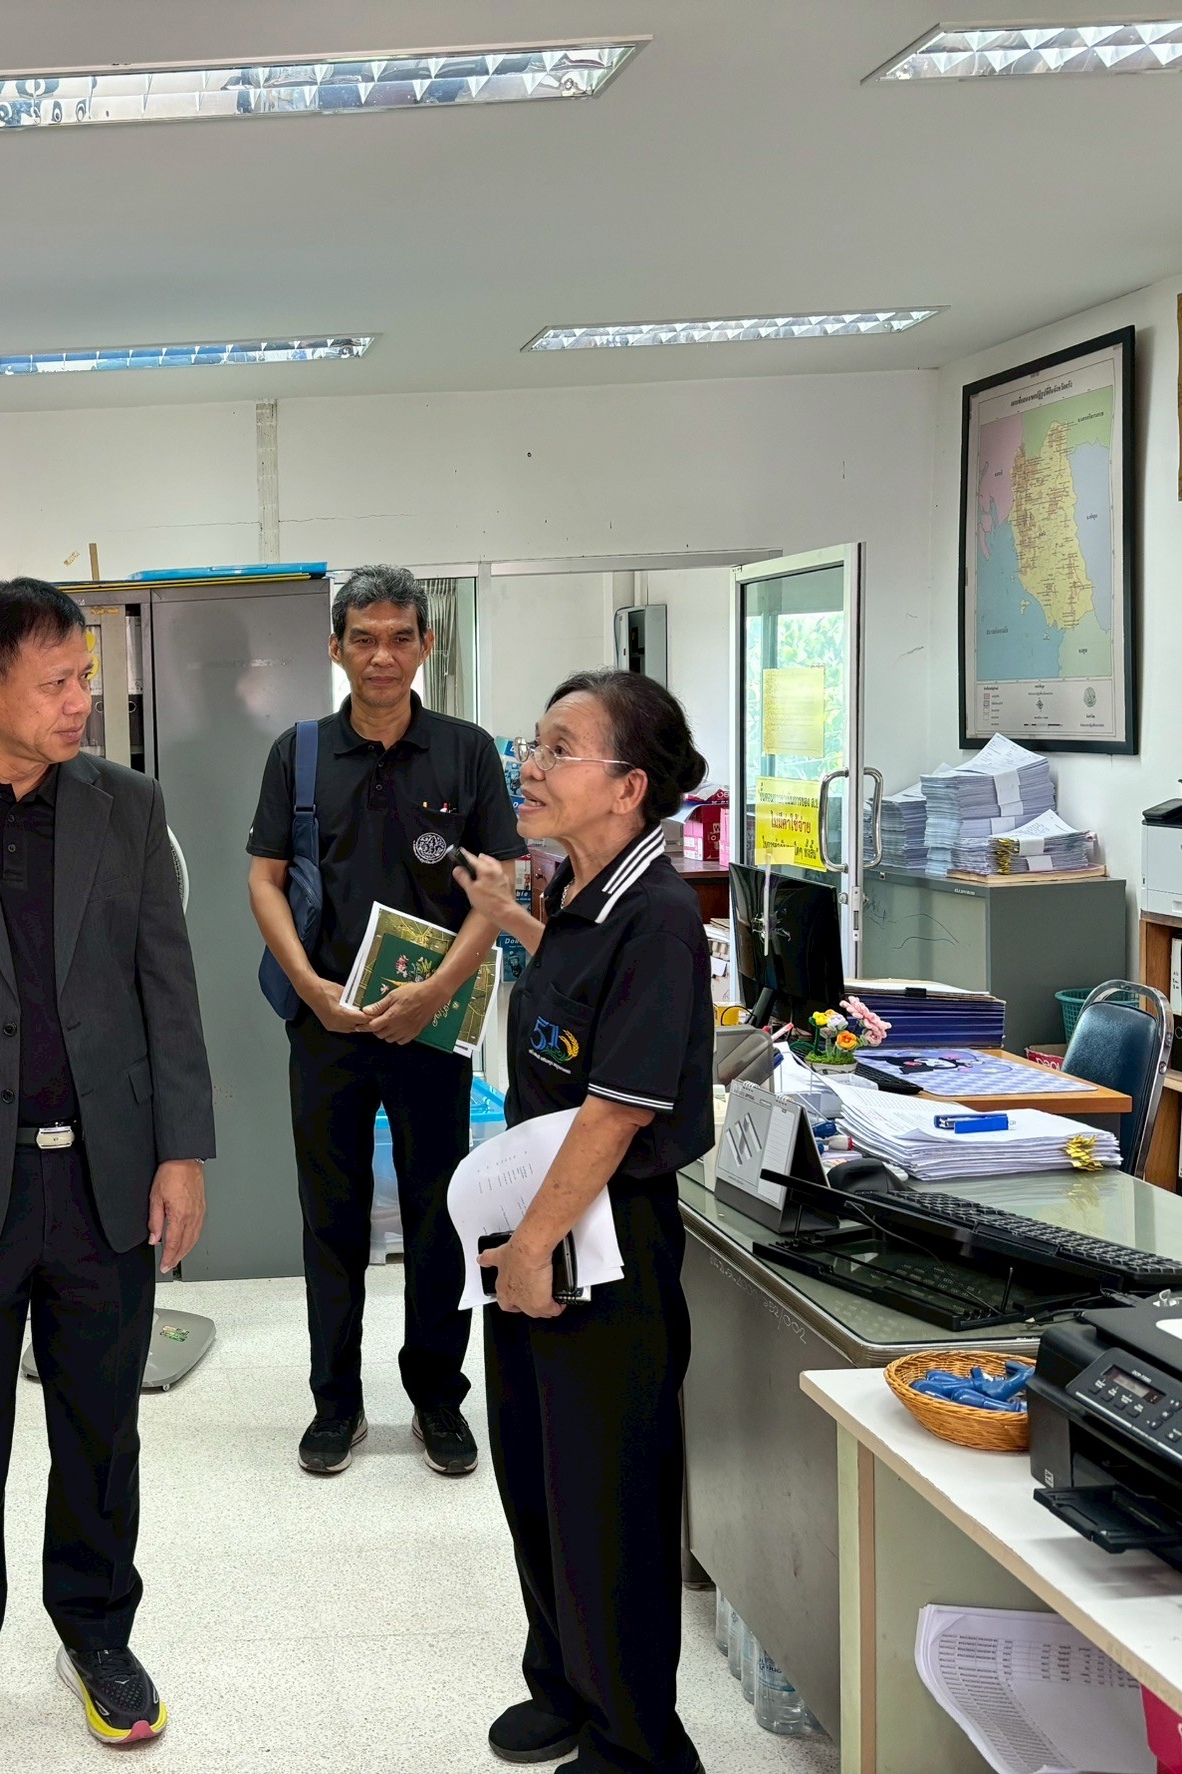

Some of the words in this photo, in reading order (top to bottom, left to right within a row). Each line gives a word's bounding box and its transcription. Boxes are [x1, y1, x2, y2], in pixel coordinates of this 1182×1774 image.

[770, 810, 812, 834] ไม่มีค่าใช้จ่าย
